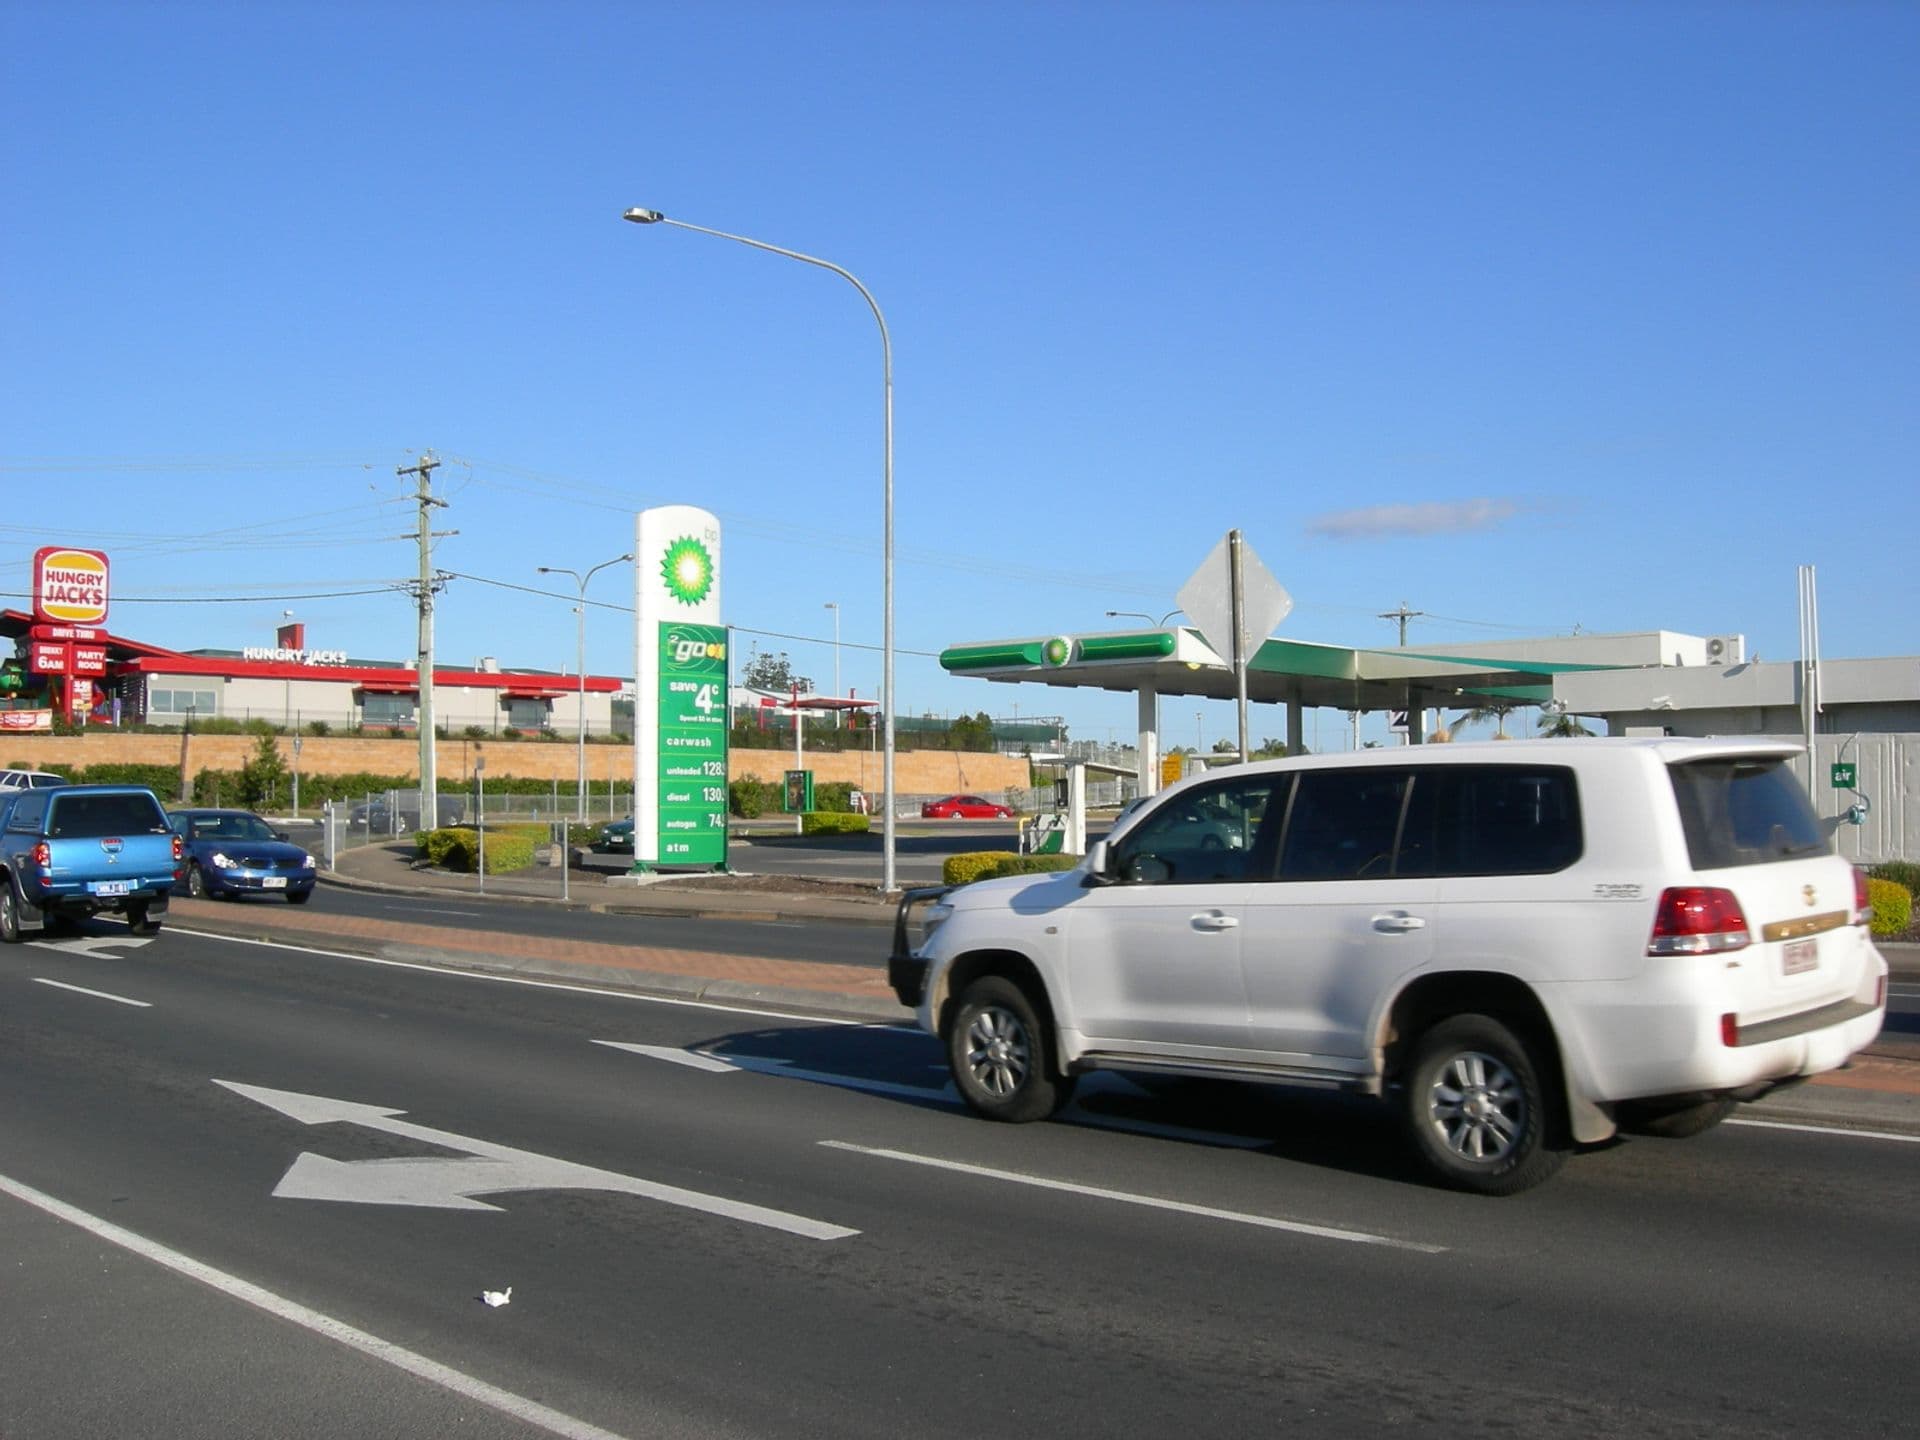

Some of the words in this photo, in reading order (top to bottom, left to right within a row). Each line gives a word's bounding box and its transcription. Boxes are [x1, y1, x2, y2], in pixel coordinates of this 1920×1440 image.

[704, 526, 717, 542] bp
[46, 570, 103, 586] HUNGRY
[45, 584, 103, 605] JACK'S
[77, 651, 104, 660] PARTY
[243, 647, 303, 662] HUNGRY
[38, 656, 64, 670] 6AM
[78, 660, 103, 670] ROOM
[670, 681, 698, 692] save
[666, 737, 712, 747] carwash
[666, 767, 702, 775] unleaded
[1835, 768, 1852, 781] air
[666, 793, 690, 801] diesel
[666, 843, 689, 852] atm
